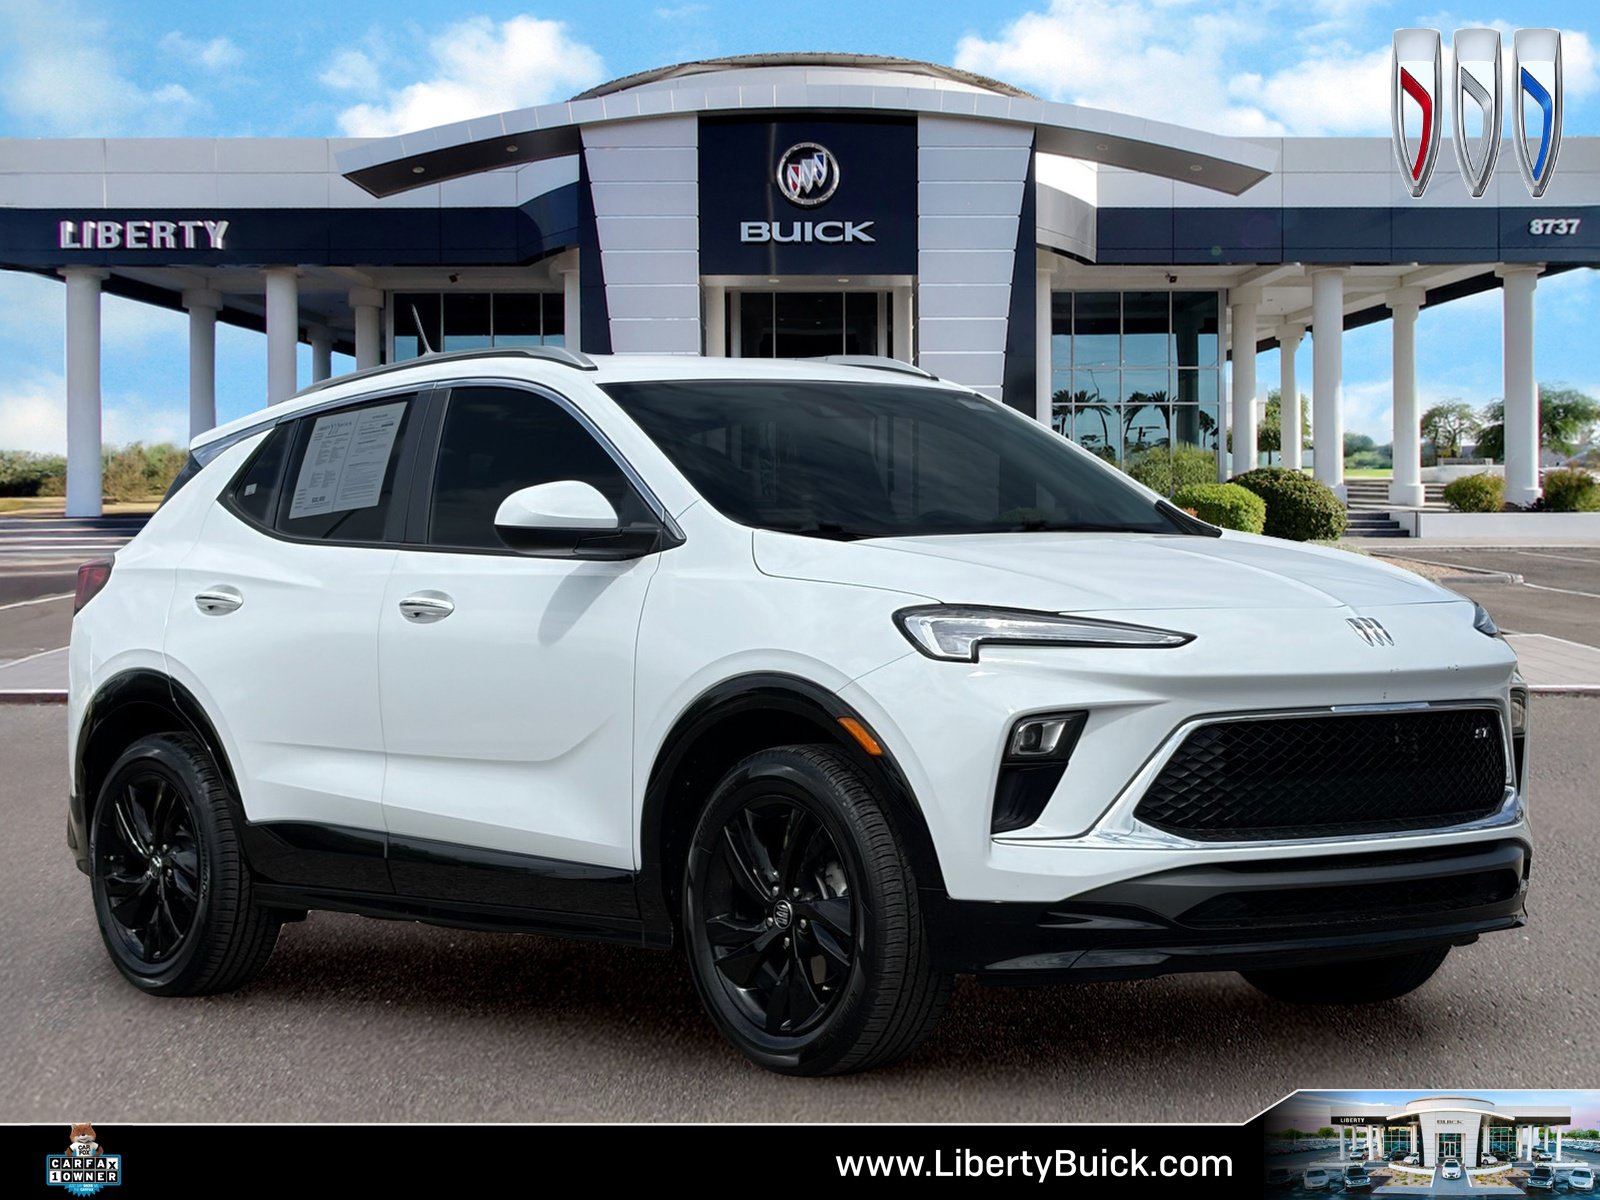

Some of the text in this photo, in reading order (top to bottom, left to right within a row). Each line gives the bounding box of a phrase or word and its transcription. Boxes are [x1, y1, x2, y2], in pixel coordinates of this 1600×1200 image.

[60, 220, 229, 249] LIBERTY
[740, 221, 876, 243] BUICK
[1529, 218, 1580, 235] 8737
